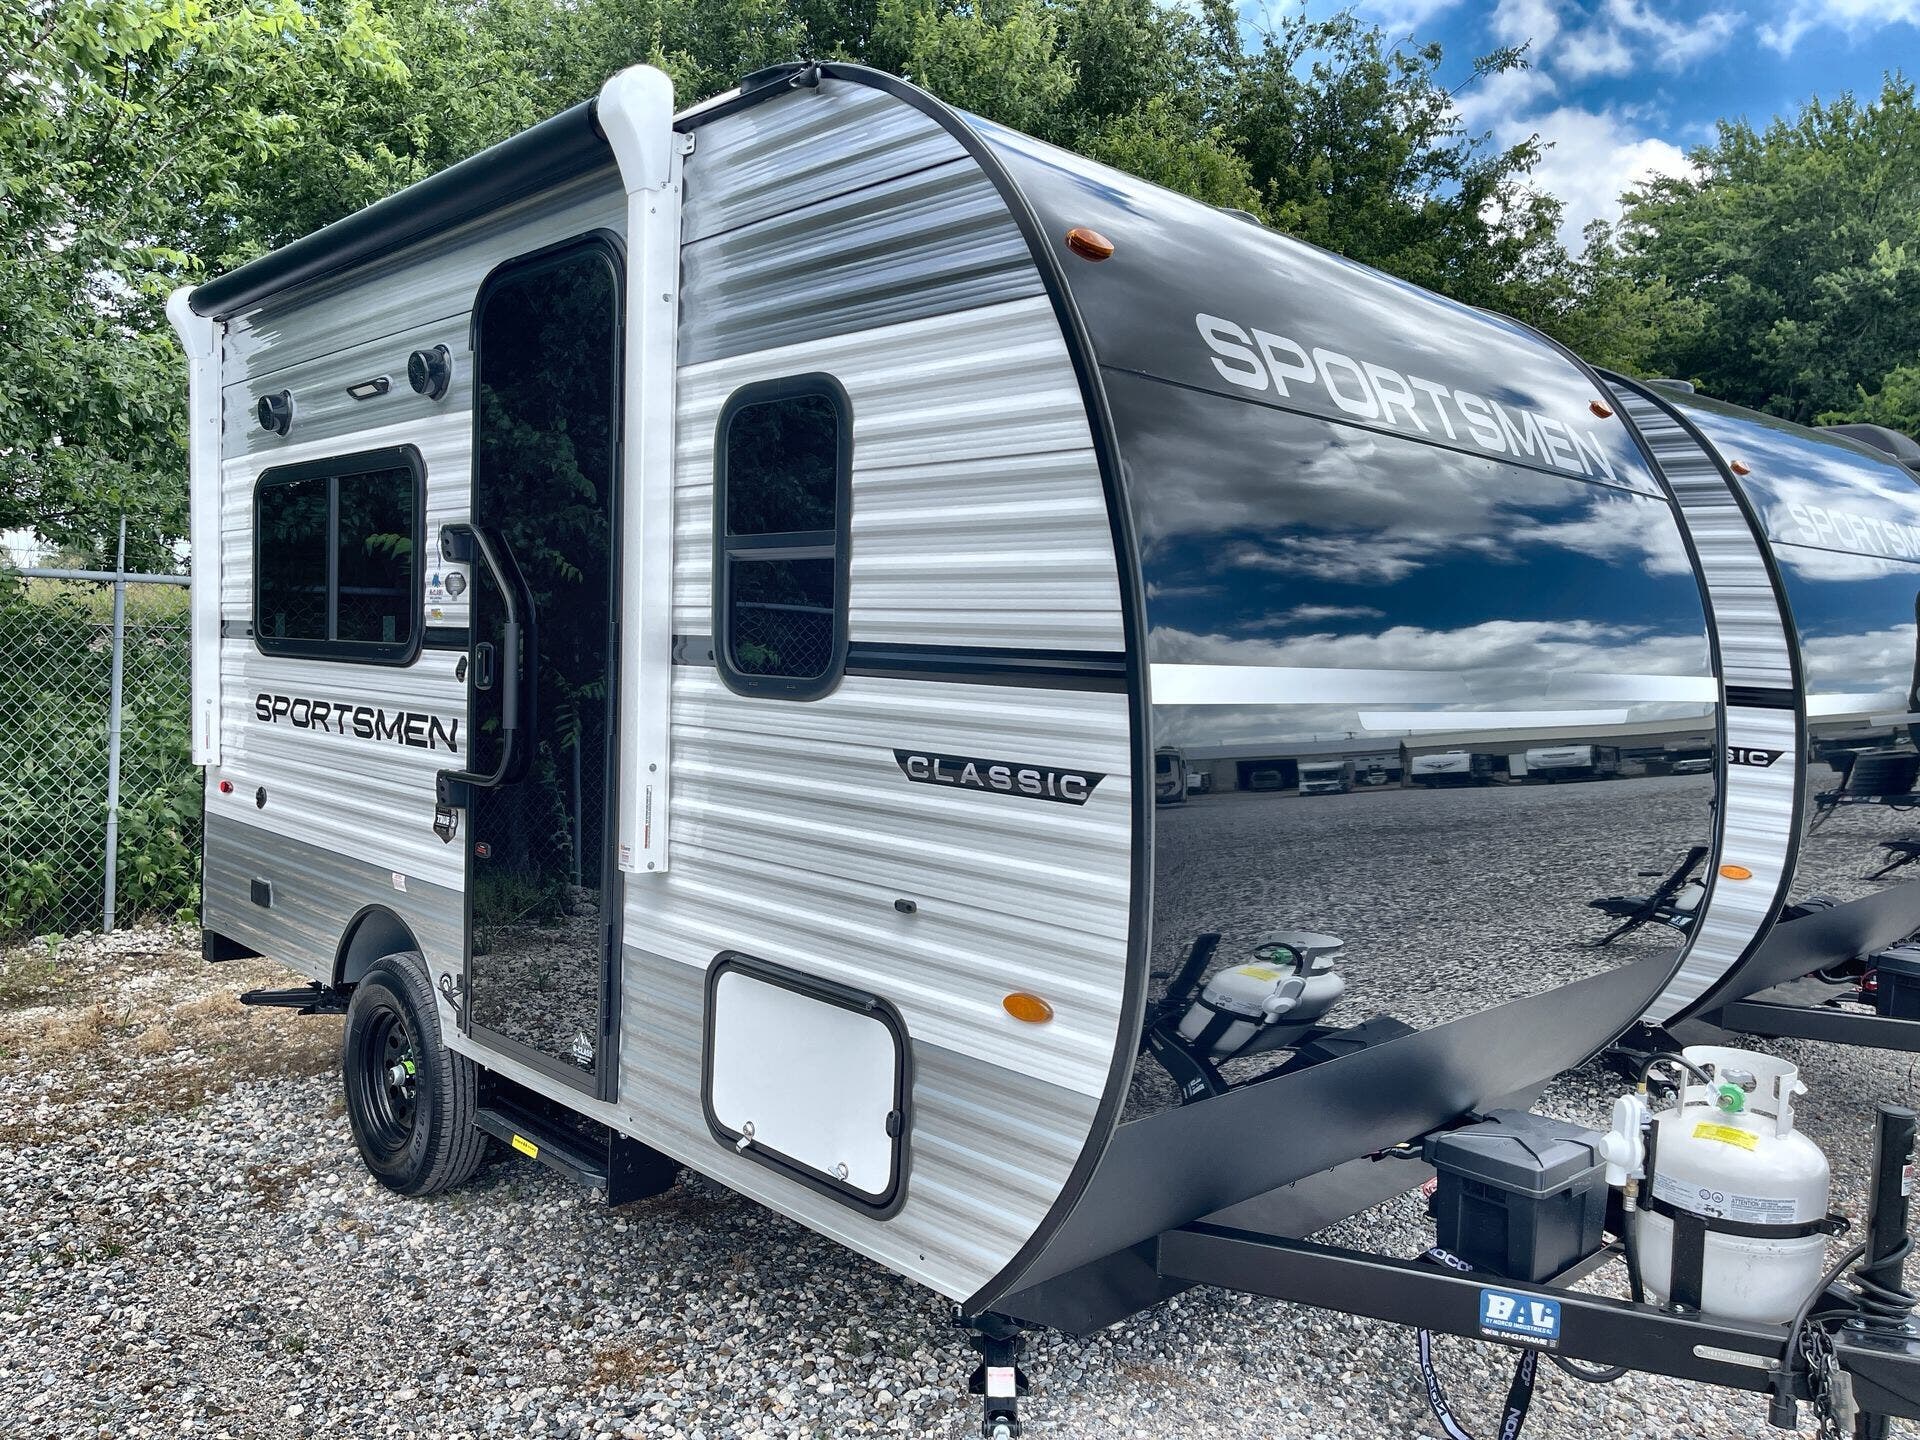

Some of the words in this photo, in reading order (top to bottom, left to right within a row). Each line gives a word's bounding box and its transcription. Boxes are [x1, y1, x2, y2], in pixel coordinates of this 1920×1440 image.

[1195, 313, 1618, 481] SPORTSMEN
[255, 693, 459, 753] SPORTSMEN
[906, 755, 1088, 801] CLASSIC
[1486, 1293, 1555, 1328] BAL
